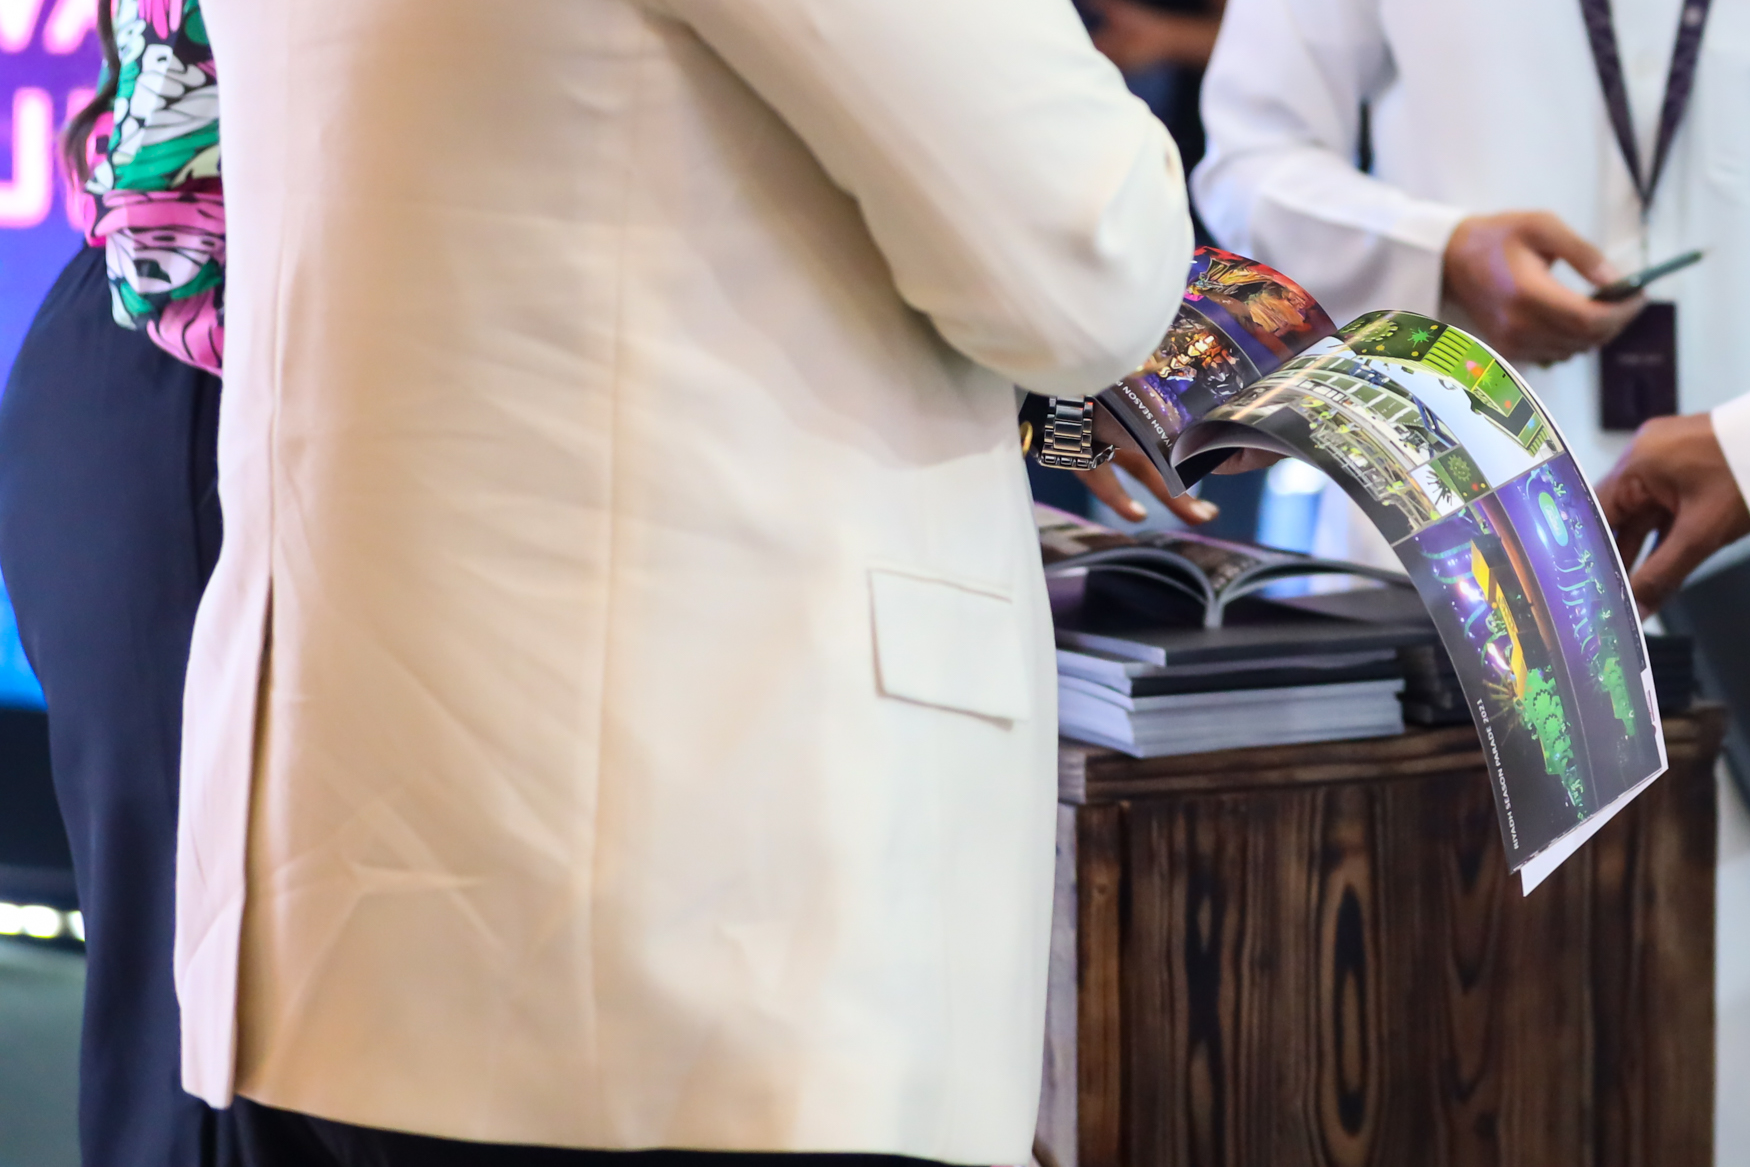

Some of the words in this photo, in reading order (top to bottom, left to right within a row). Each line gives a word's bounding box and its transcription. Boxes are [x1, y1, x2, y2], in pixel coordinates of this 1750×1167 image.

[1122, 386, 1154, 420] SEASON
[1151, 419, 1173, 448] IYADH
[1476, 697, 1490, 724] 2021
[1485, 725, 1501, 767] PARADE
[1497, 768, 1512, 810] SEASON
[1507, 811, 1519, 850] RIYADH
